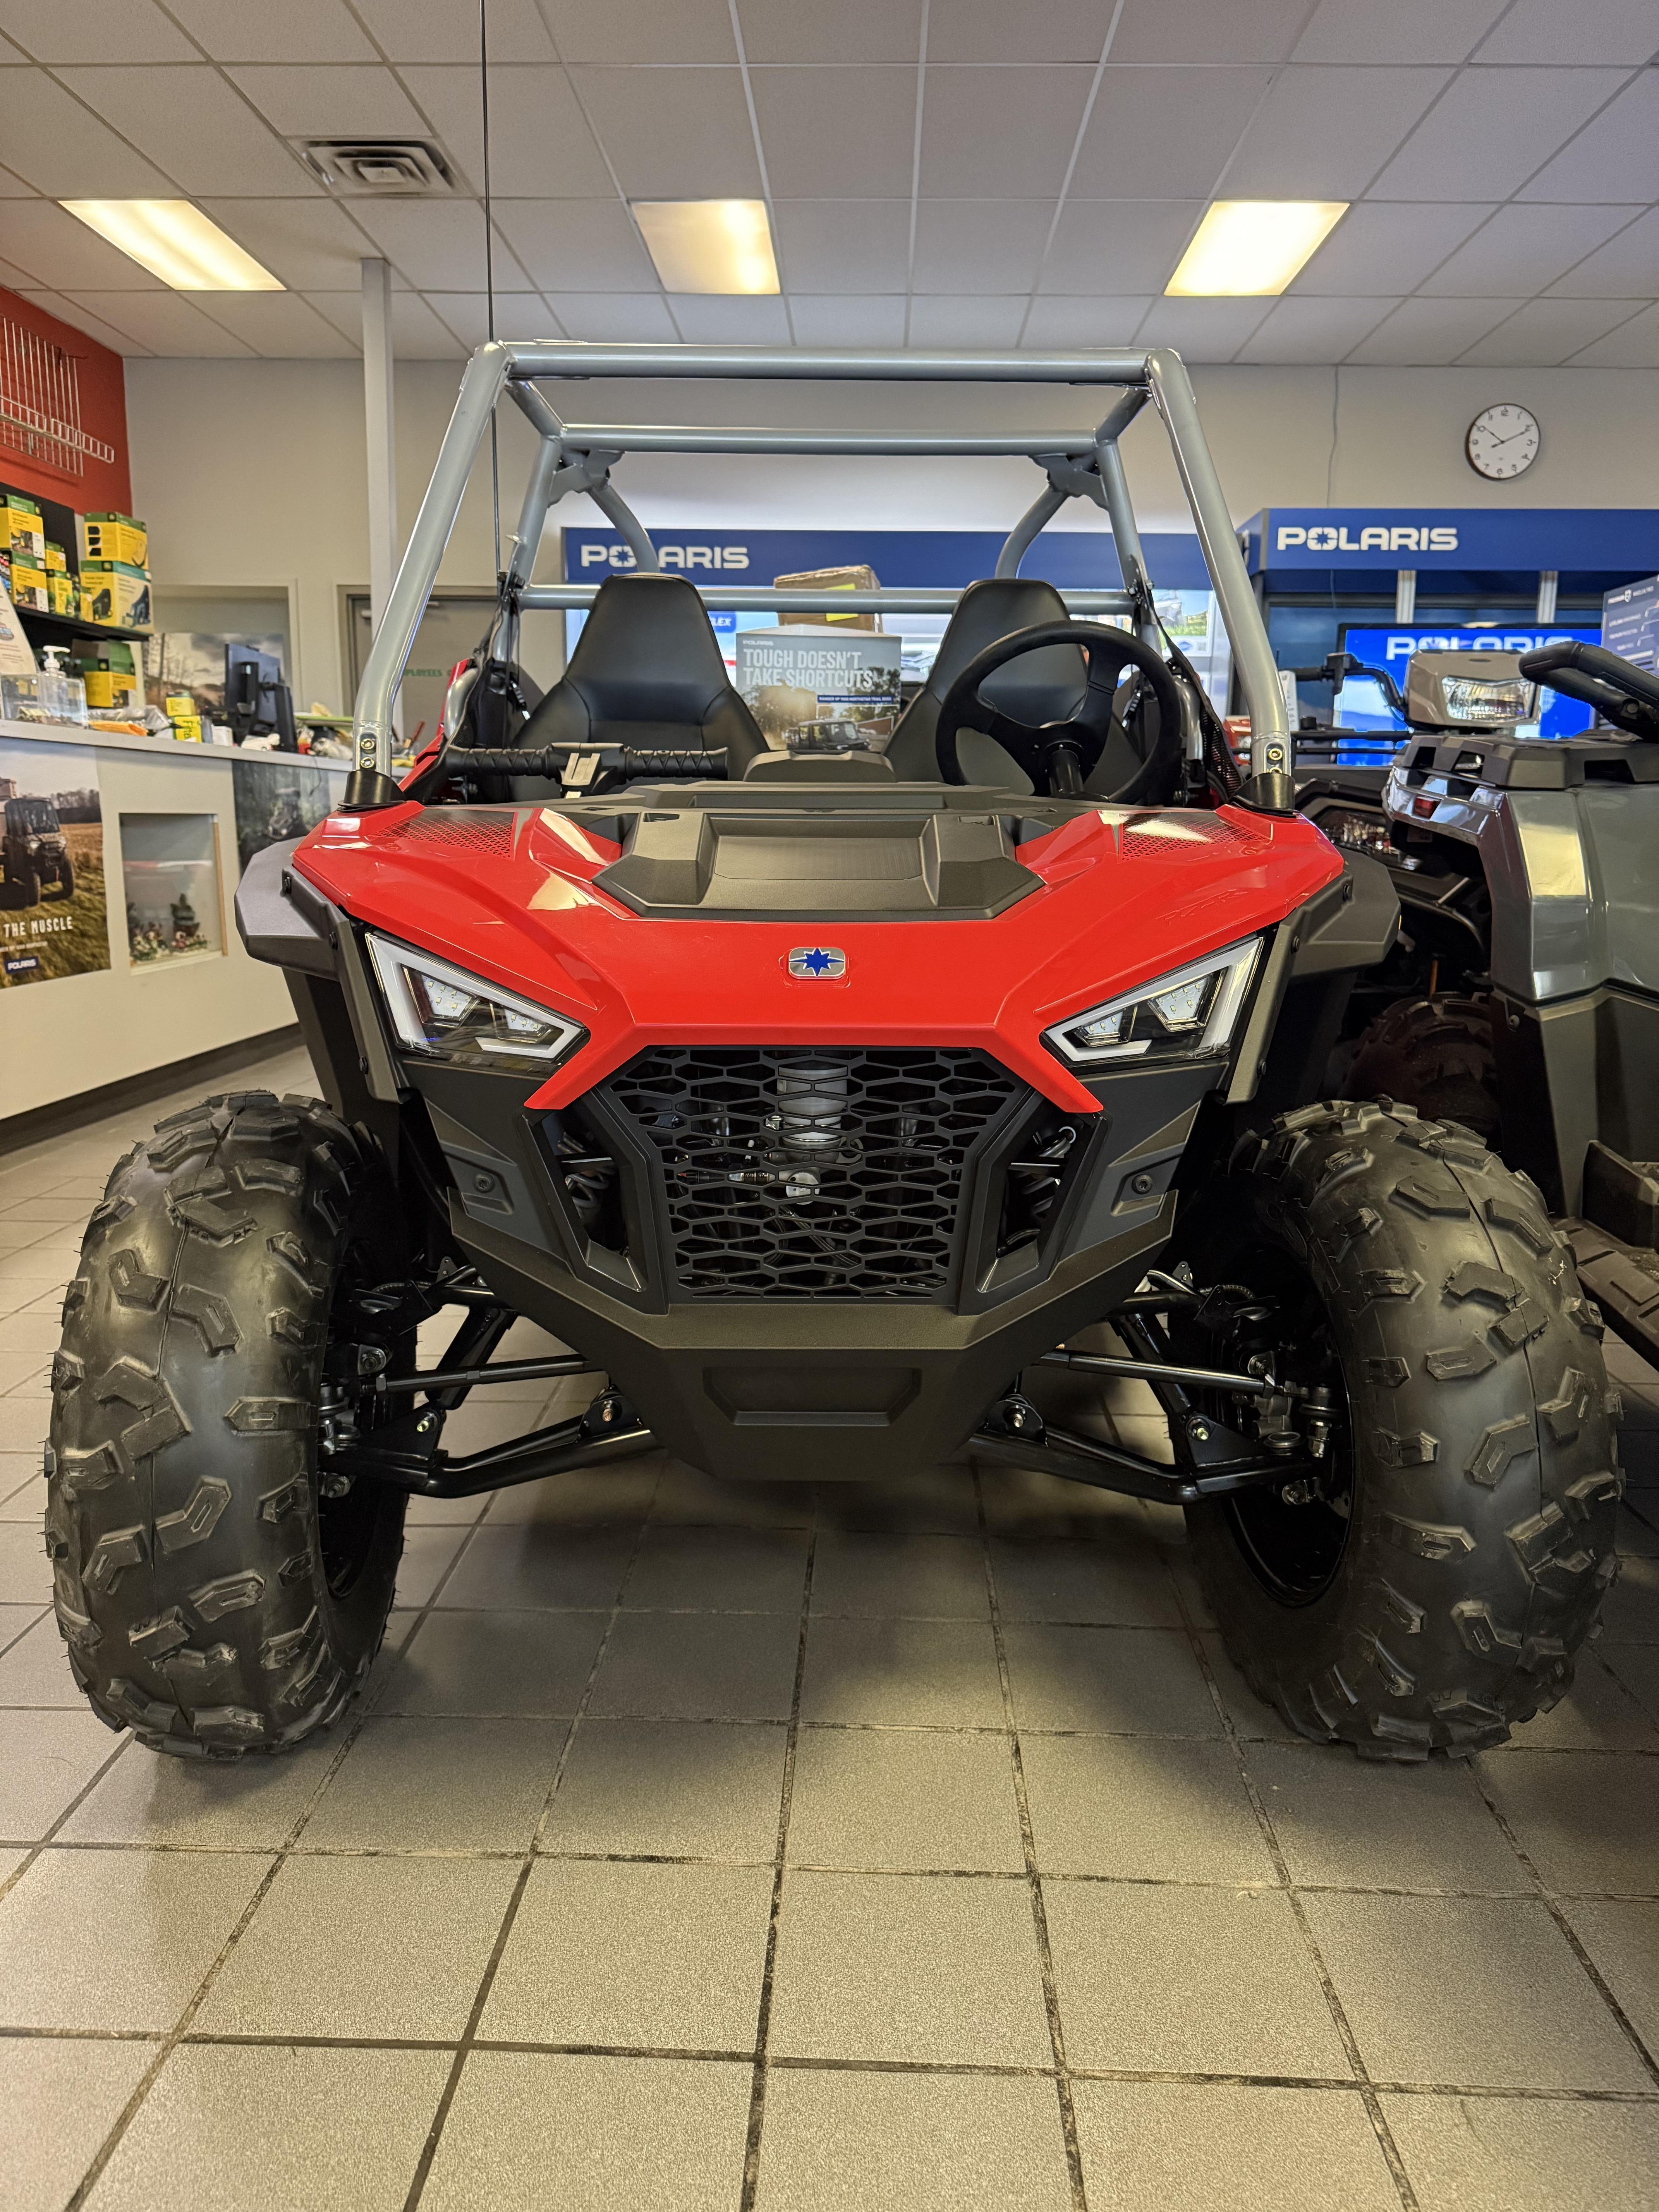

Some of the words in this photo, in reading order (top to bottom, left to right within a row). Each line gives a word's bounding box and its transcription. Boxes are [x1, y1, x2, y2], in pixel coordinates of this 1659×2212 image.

[1277, 527, 1458, 551] POLARIS
[581, 545, 750, 569] POARIS
[711, 617, 732, 626] LEX
[743, 648, 793, 668] TOUGH
[797, 651, 862, 670] DOESN'T
[743, 667, 783, 687] TAKE
[785, 669, 873, 689] SHORTCUTS
[3, 921, 26, 938] THE
[31, 915, 73, 934] MUSCLE
